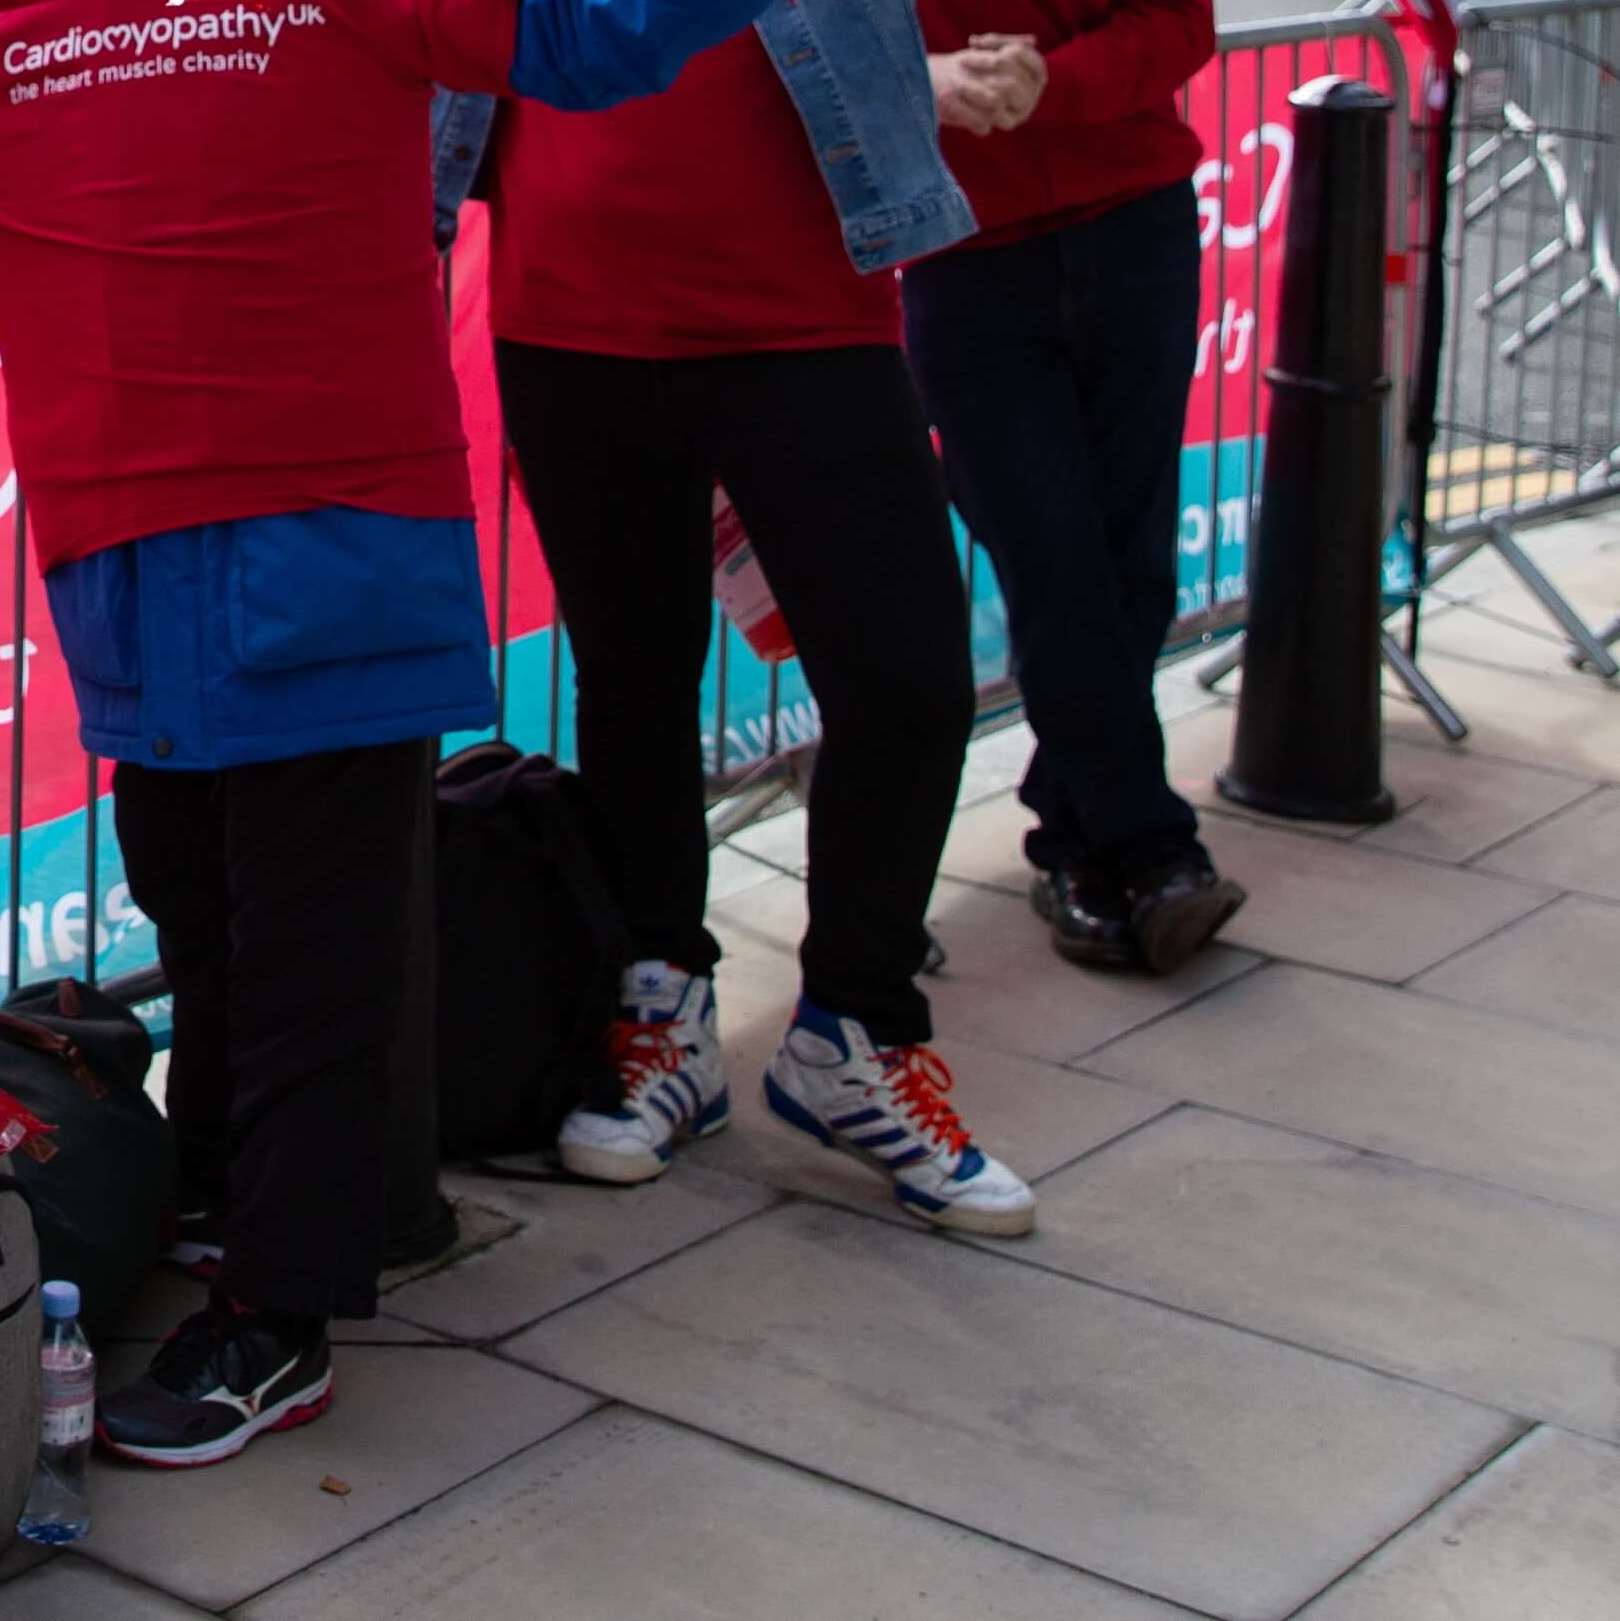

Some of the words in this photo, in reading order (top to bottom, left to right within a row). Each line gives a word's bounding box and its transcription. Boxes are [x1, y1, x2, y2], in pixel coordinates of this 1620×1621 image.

[3, 3, 286, 75] Cardiomyopathy
[287, 3, 327, 26] UK
[9, 81, 40, 106] the
[43, 67, 94, 96] heart
[97, 53, 178, 86] muscle
[182, 48, 271, 75] charity
